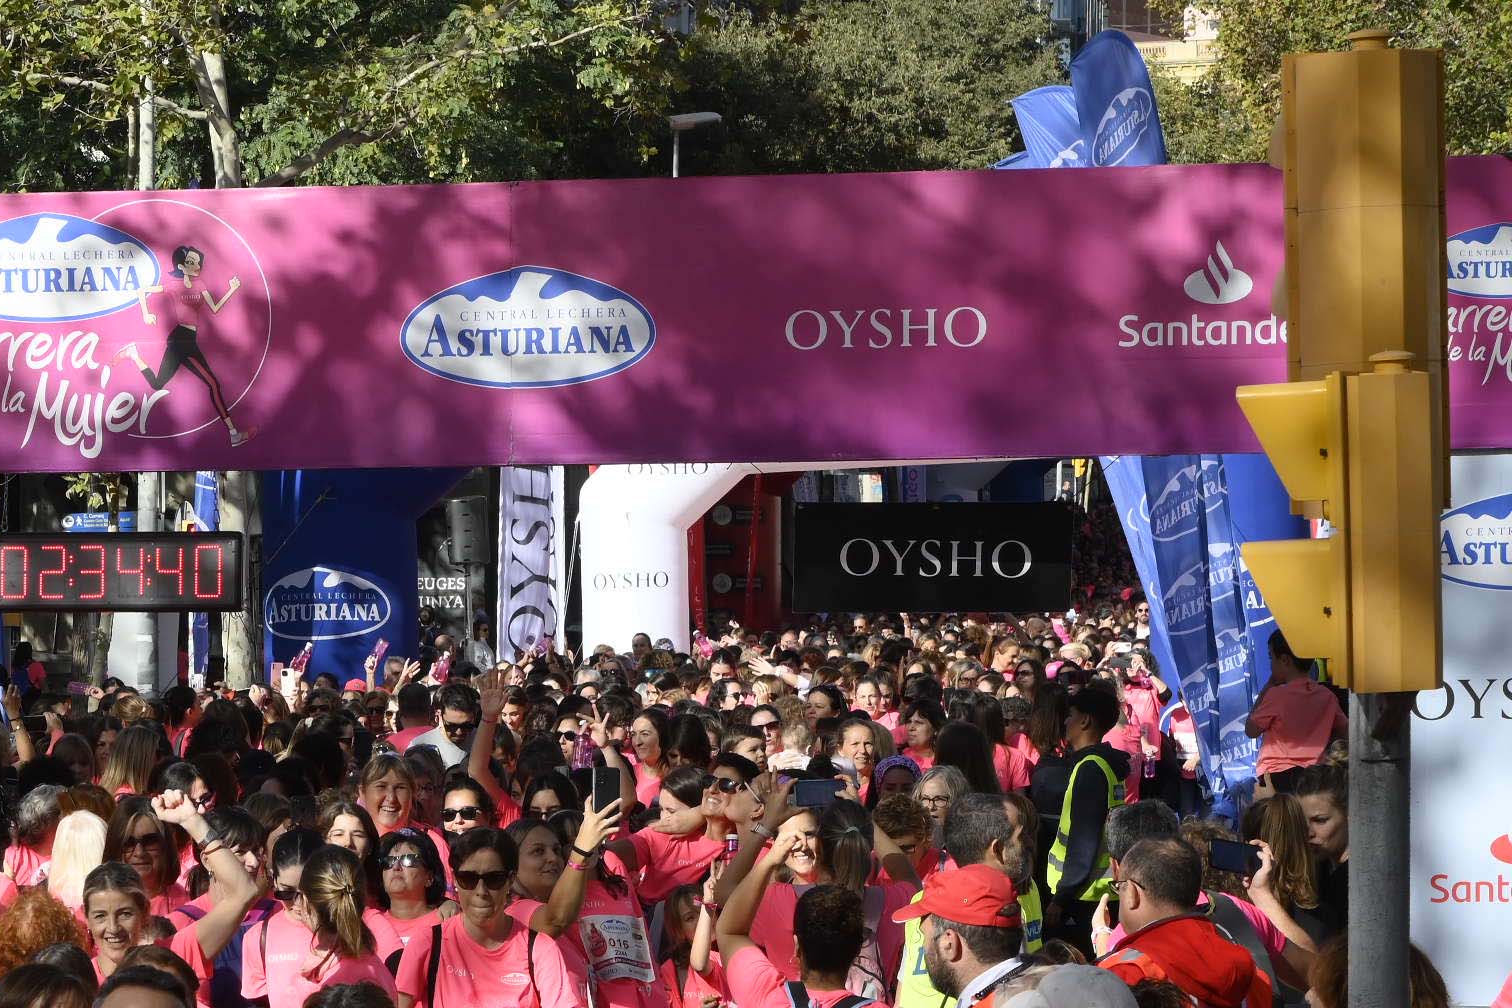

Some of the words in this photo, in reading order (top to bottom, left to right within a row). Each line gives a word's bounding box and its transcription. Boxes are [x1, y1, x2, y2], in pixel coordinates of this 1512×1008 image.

[63, 249, 135, 260] LECHERA
[459, 309, 538, 321] CENTRAL
[546, 307, 628, 319] LECHERA
[785, 307, 988, 350] OYSHO
[1118, 313, 1289, 348] Santande
[421, 312, 636, 360] ASTURIANA
[1, 373, 26, 413] la
[20, 365, 170, 459] Mujer
[0, 544, 223, 599] 02:34:40
[839, 538, 1033, 578] OYSHO
[593, 571, 669, 591] OYSHO
[269, 597, 381, 624] ASTURIANA
[1430, 874, 1512, 904] Sant
